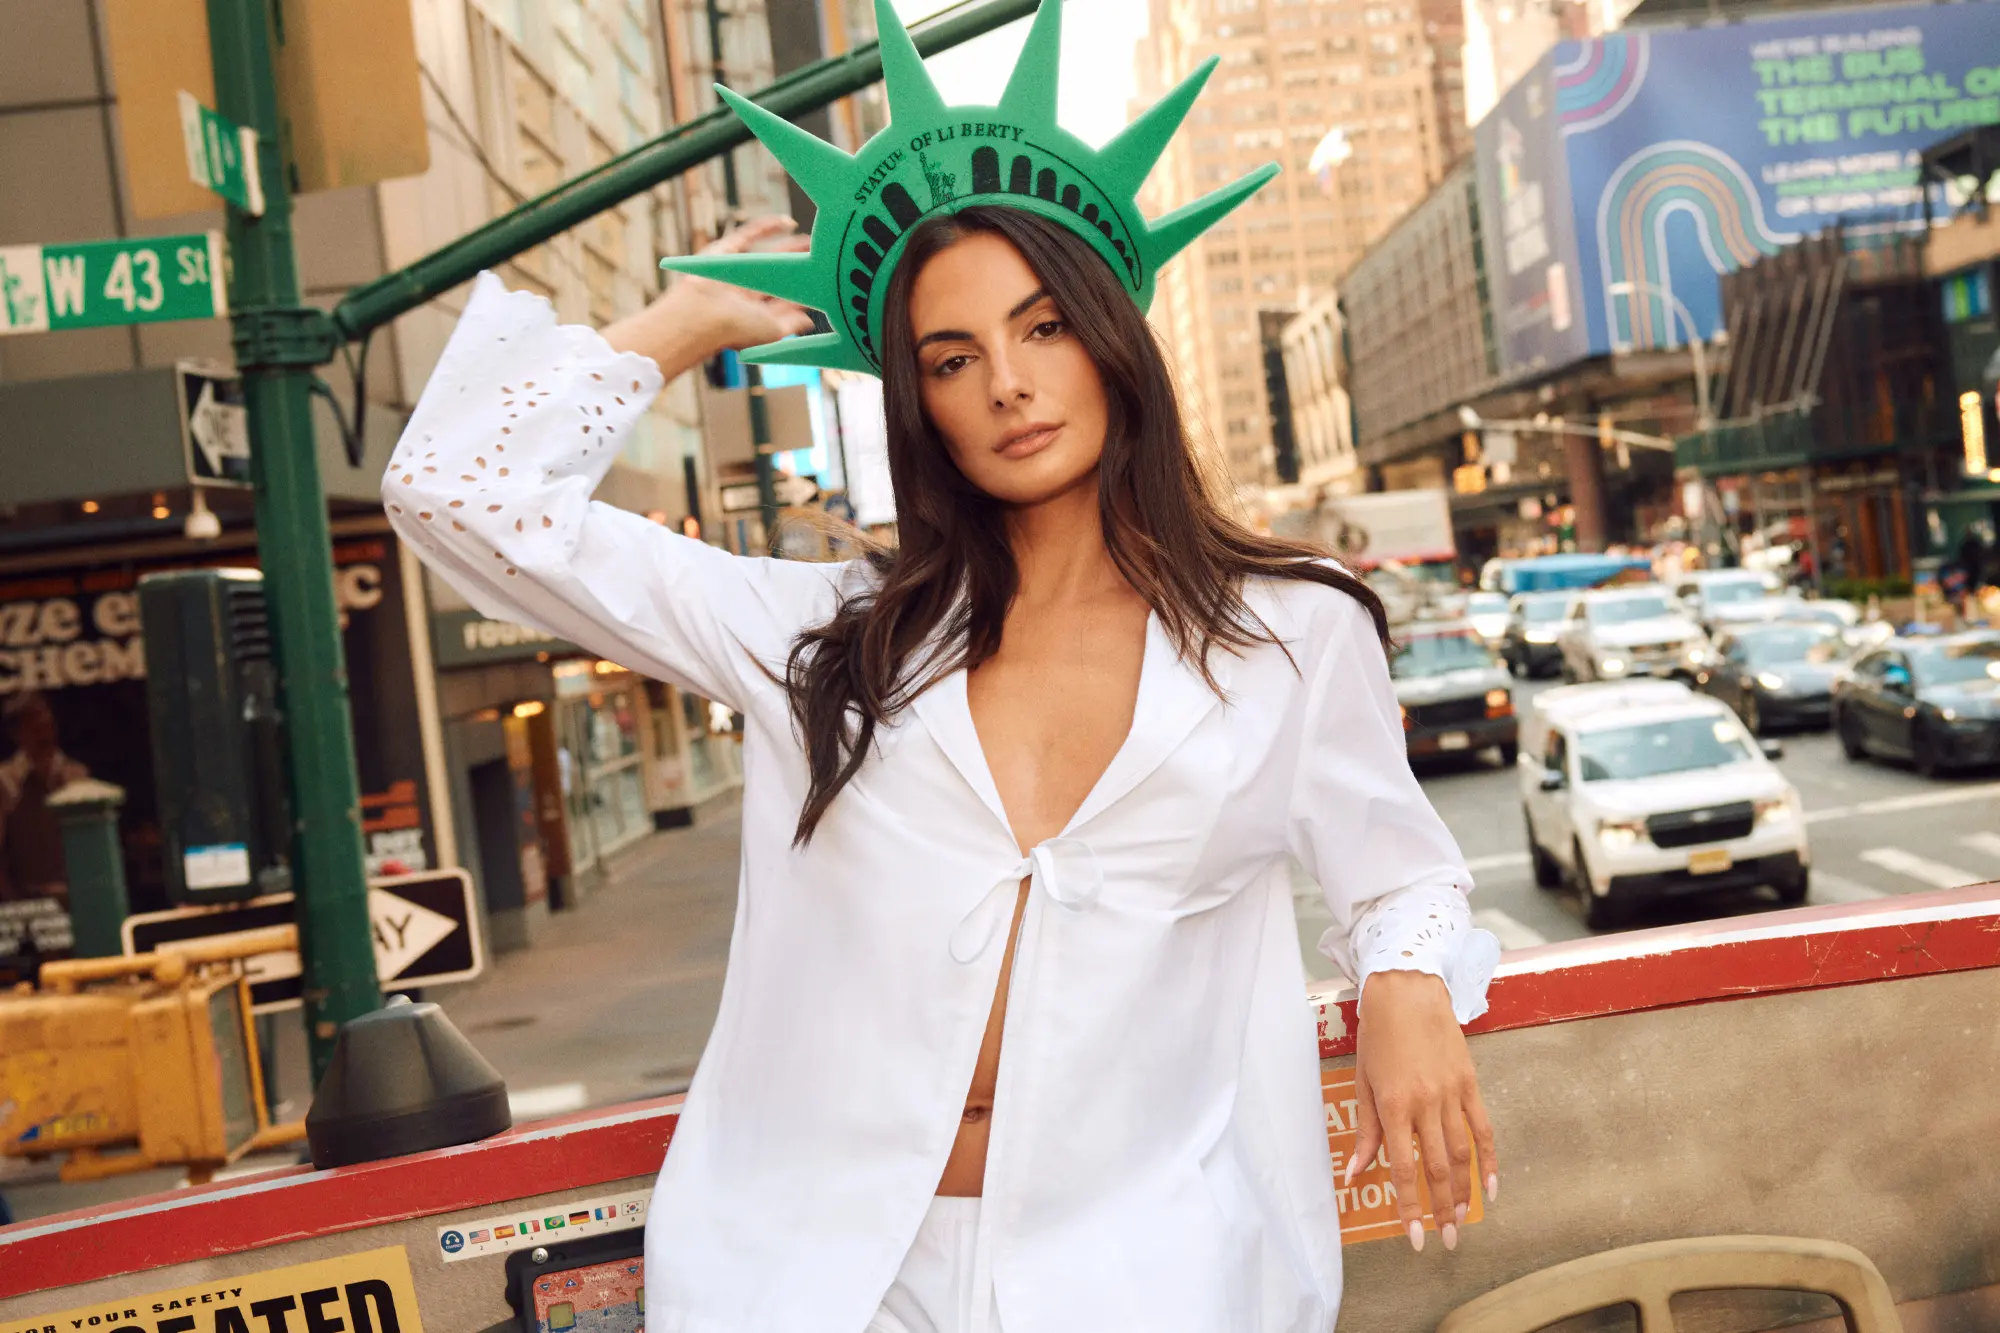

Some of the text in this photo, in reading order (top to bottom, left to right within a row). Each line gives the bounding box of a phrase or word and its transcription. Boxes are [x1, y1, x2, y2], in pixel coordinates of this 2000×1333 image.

[1754, 45, 1925, 86] THE BUS
[1757, 72, 1960, 116] TERMINAL
[910, 132, 932, 152] OF
[1760, 96, 2000, 145] THE FUTURE
[45, 254, 87, 317] W
[103, 249, 165, 313] 43
[70, 1309, 138, 1329] YOUR
[152, 1287, 243, 1314] SAFETY
